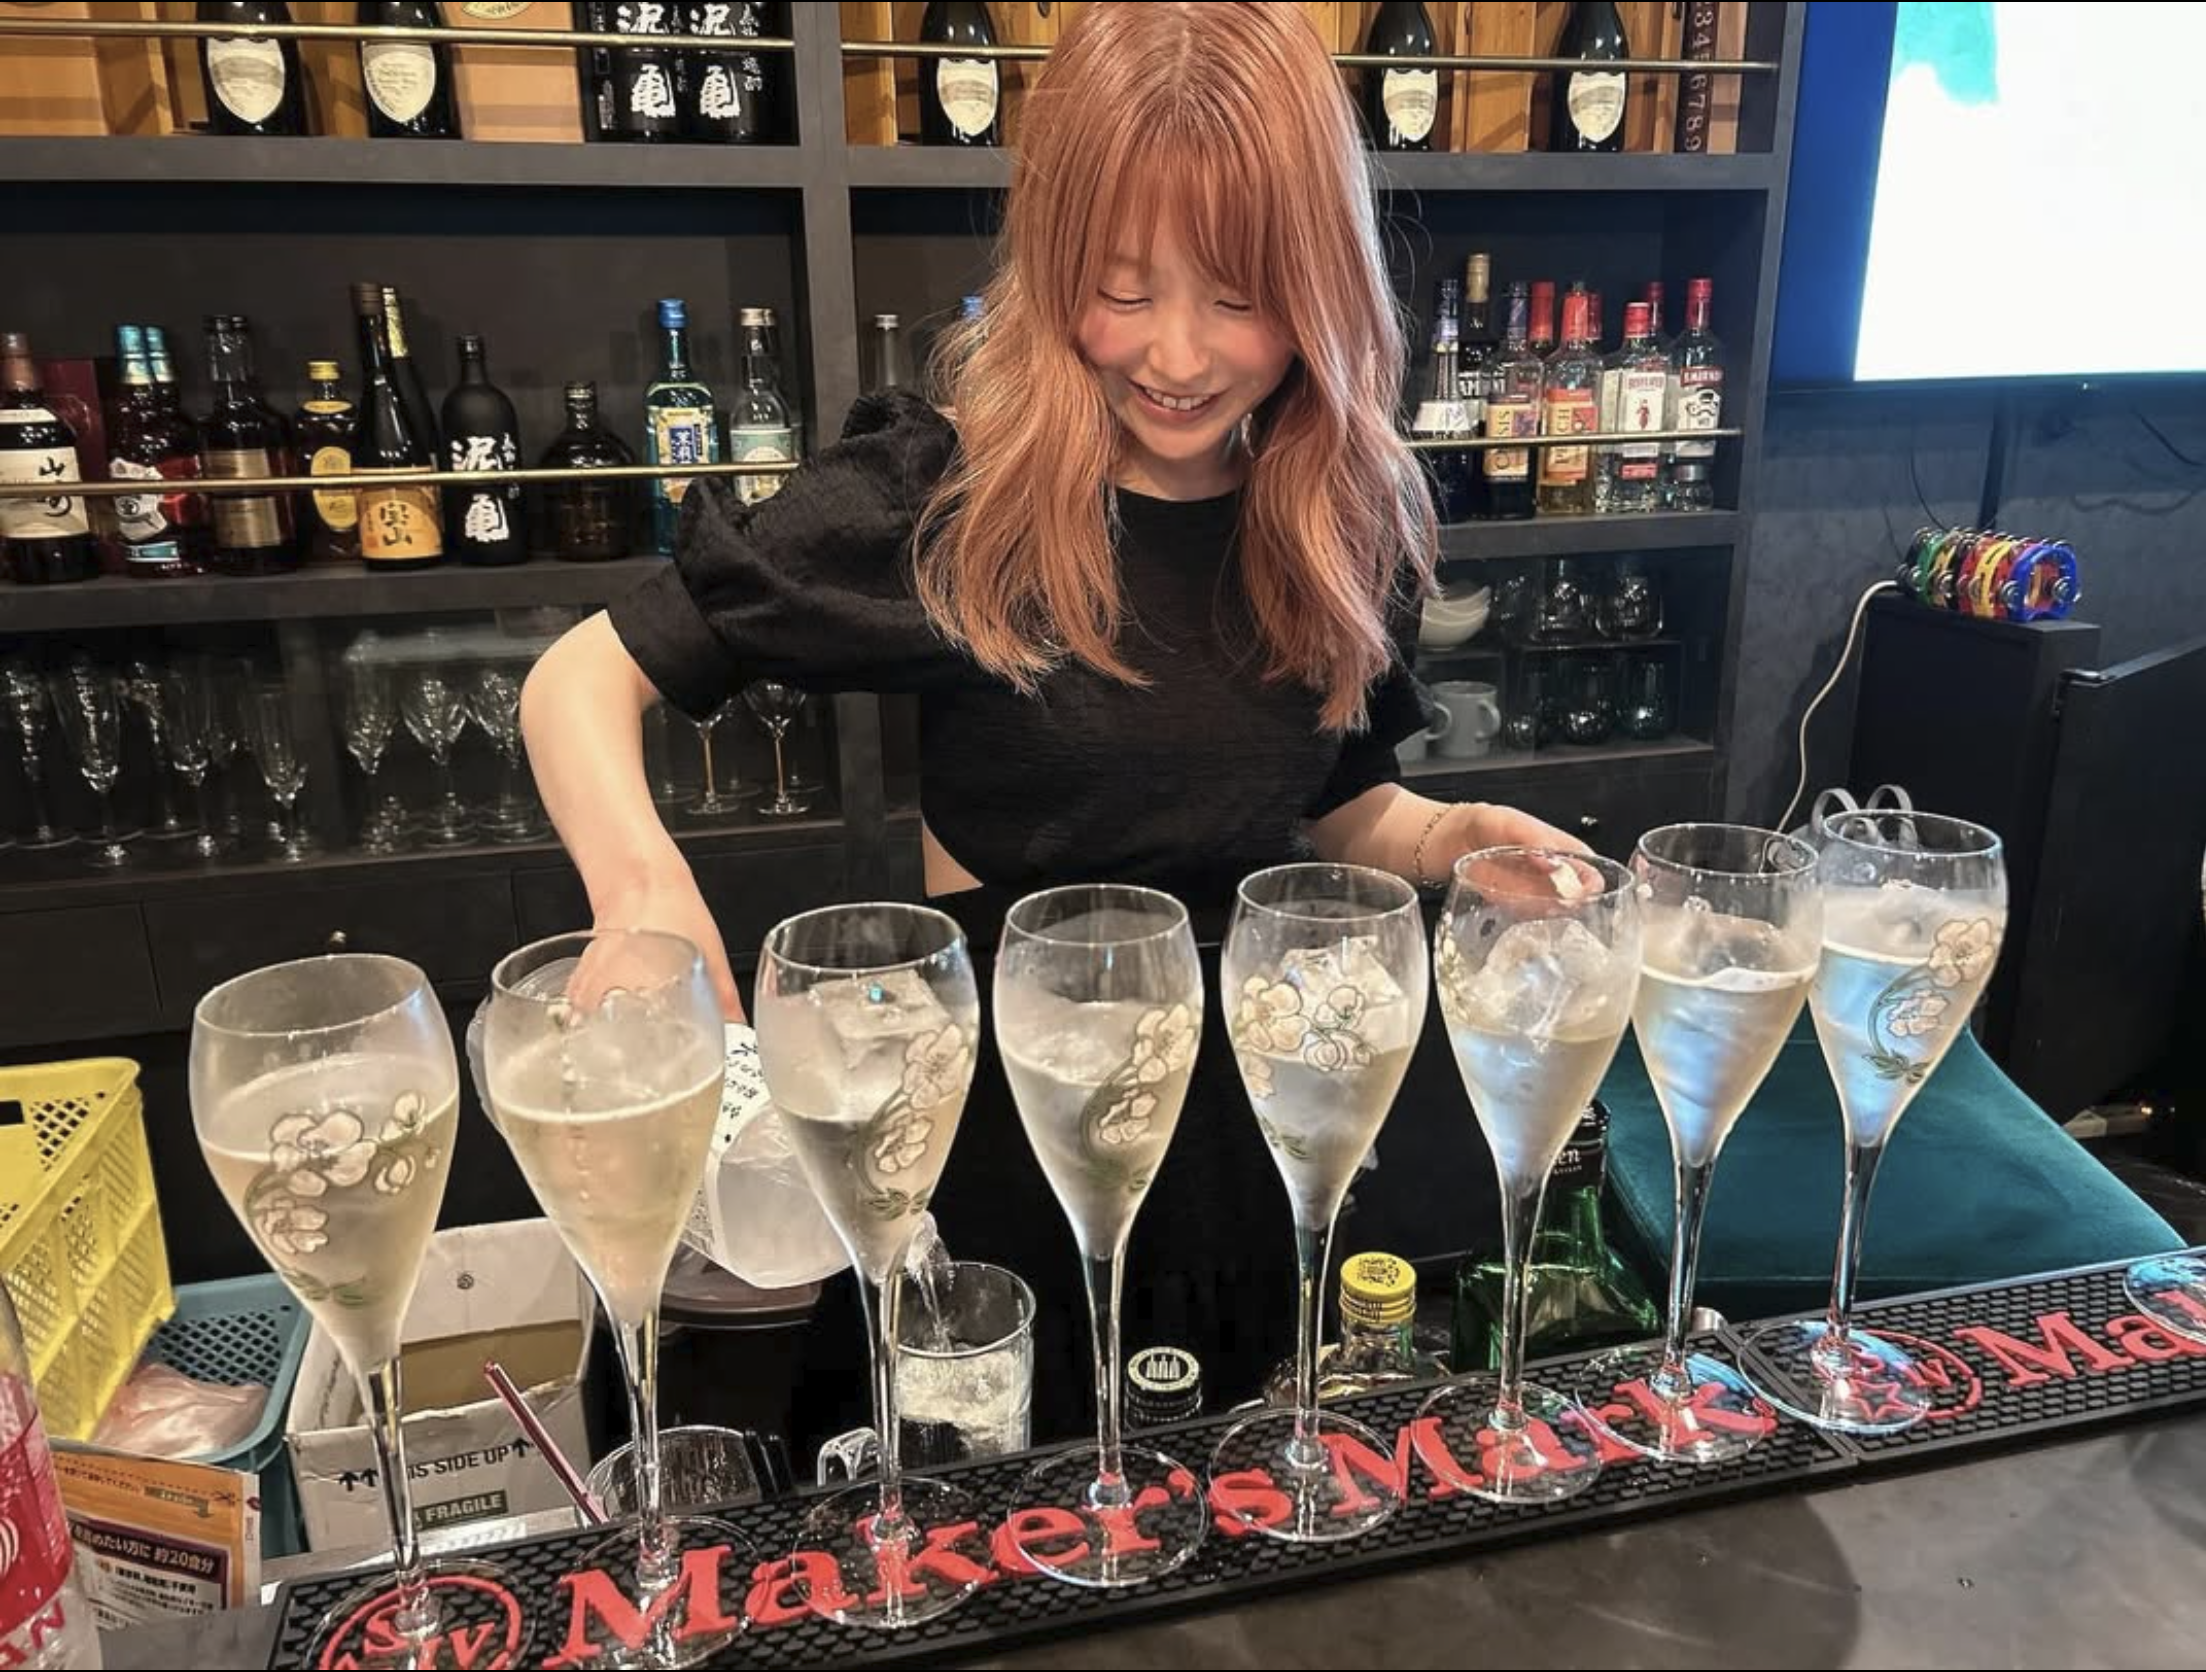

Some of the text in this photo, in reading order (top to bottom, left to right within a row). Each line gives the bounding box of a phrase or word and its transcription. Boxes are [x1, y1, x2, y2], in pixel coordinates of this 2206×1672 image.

[434, 1452, 479, 1475] SIDE
[484, 1445, 508, 1465] UP
[1318, 1377, 1777, 1516] Mark
[425, 1494, 503, 1522] FRAGILE
